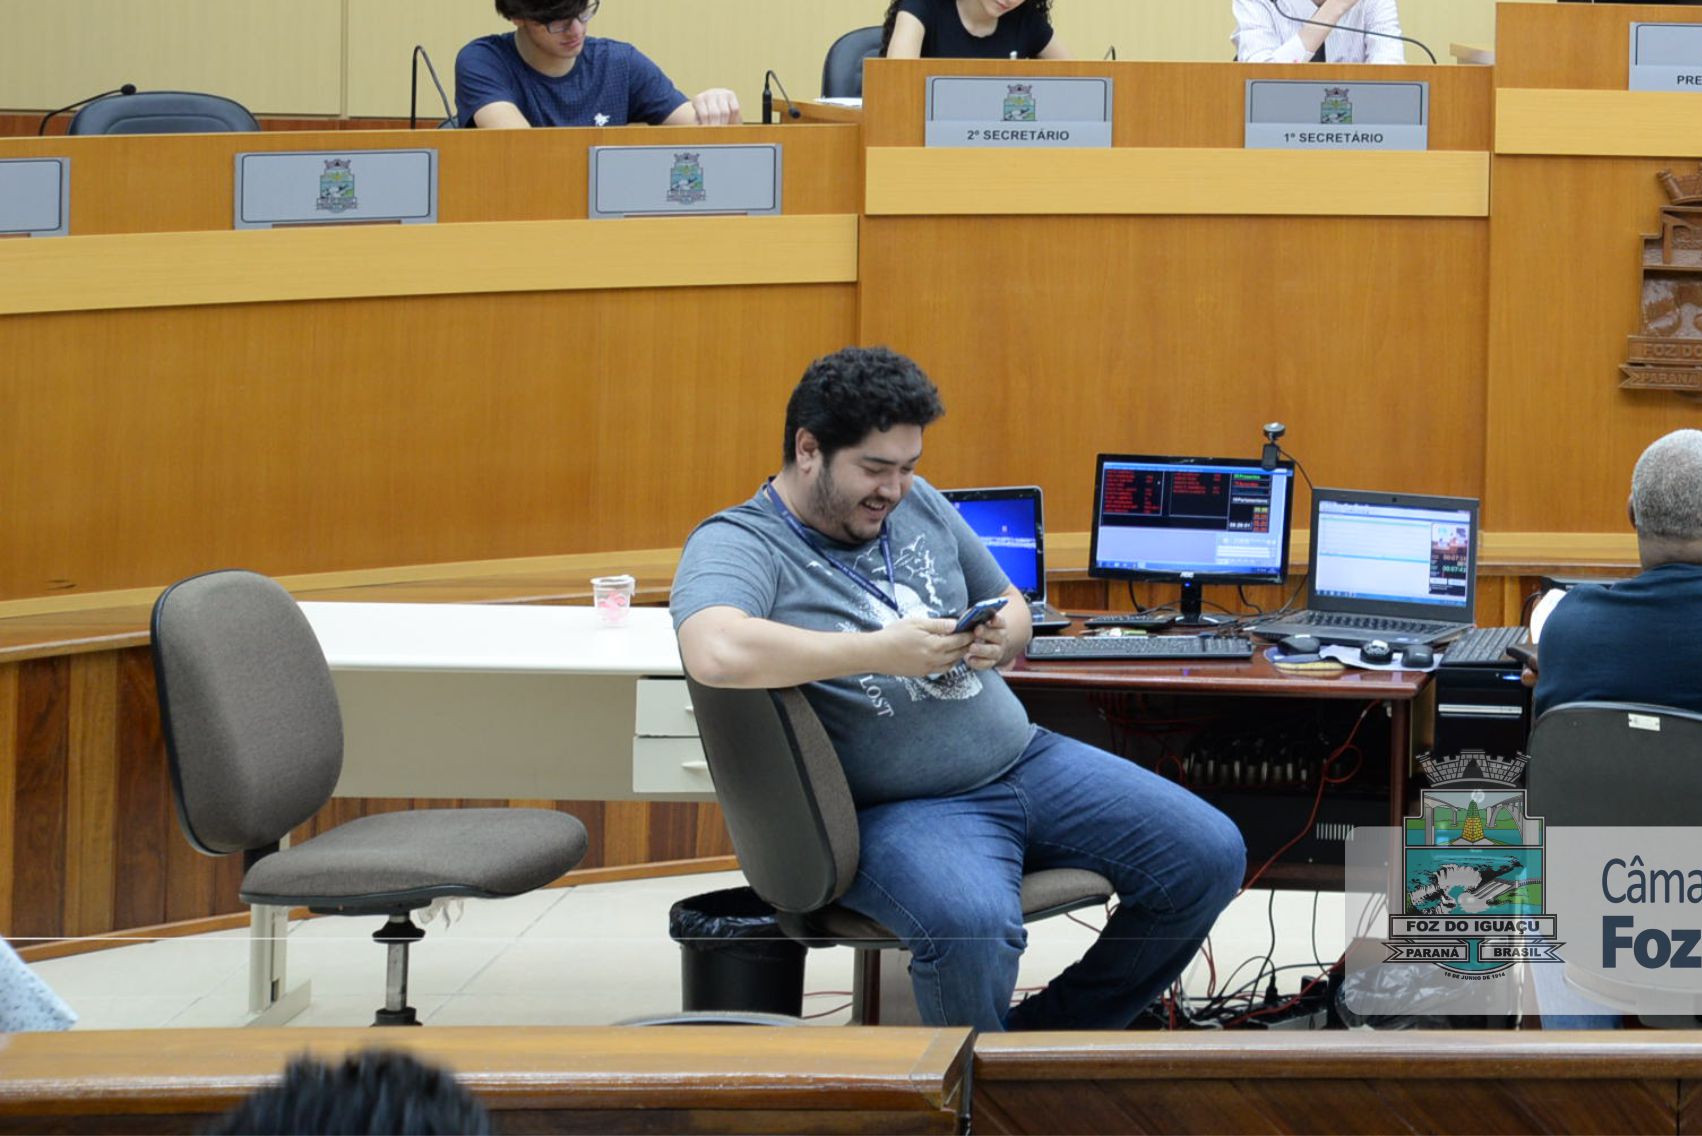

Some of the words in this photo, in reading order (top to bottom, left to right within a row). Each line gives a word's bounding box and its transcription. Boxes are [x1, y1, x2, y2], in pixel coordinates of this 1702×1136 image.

[967, 129, 980, 141] 2º
[983, 128, 1070, 141] SECRETÁRIO
[1284, 132, 1296, 143] 1º
[1299, 130, 1384, 144] SECRETÁRIO
[1643, 343, 1677, 358] FOZ
[859, 674, 895, 717] LOST
